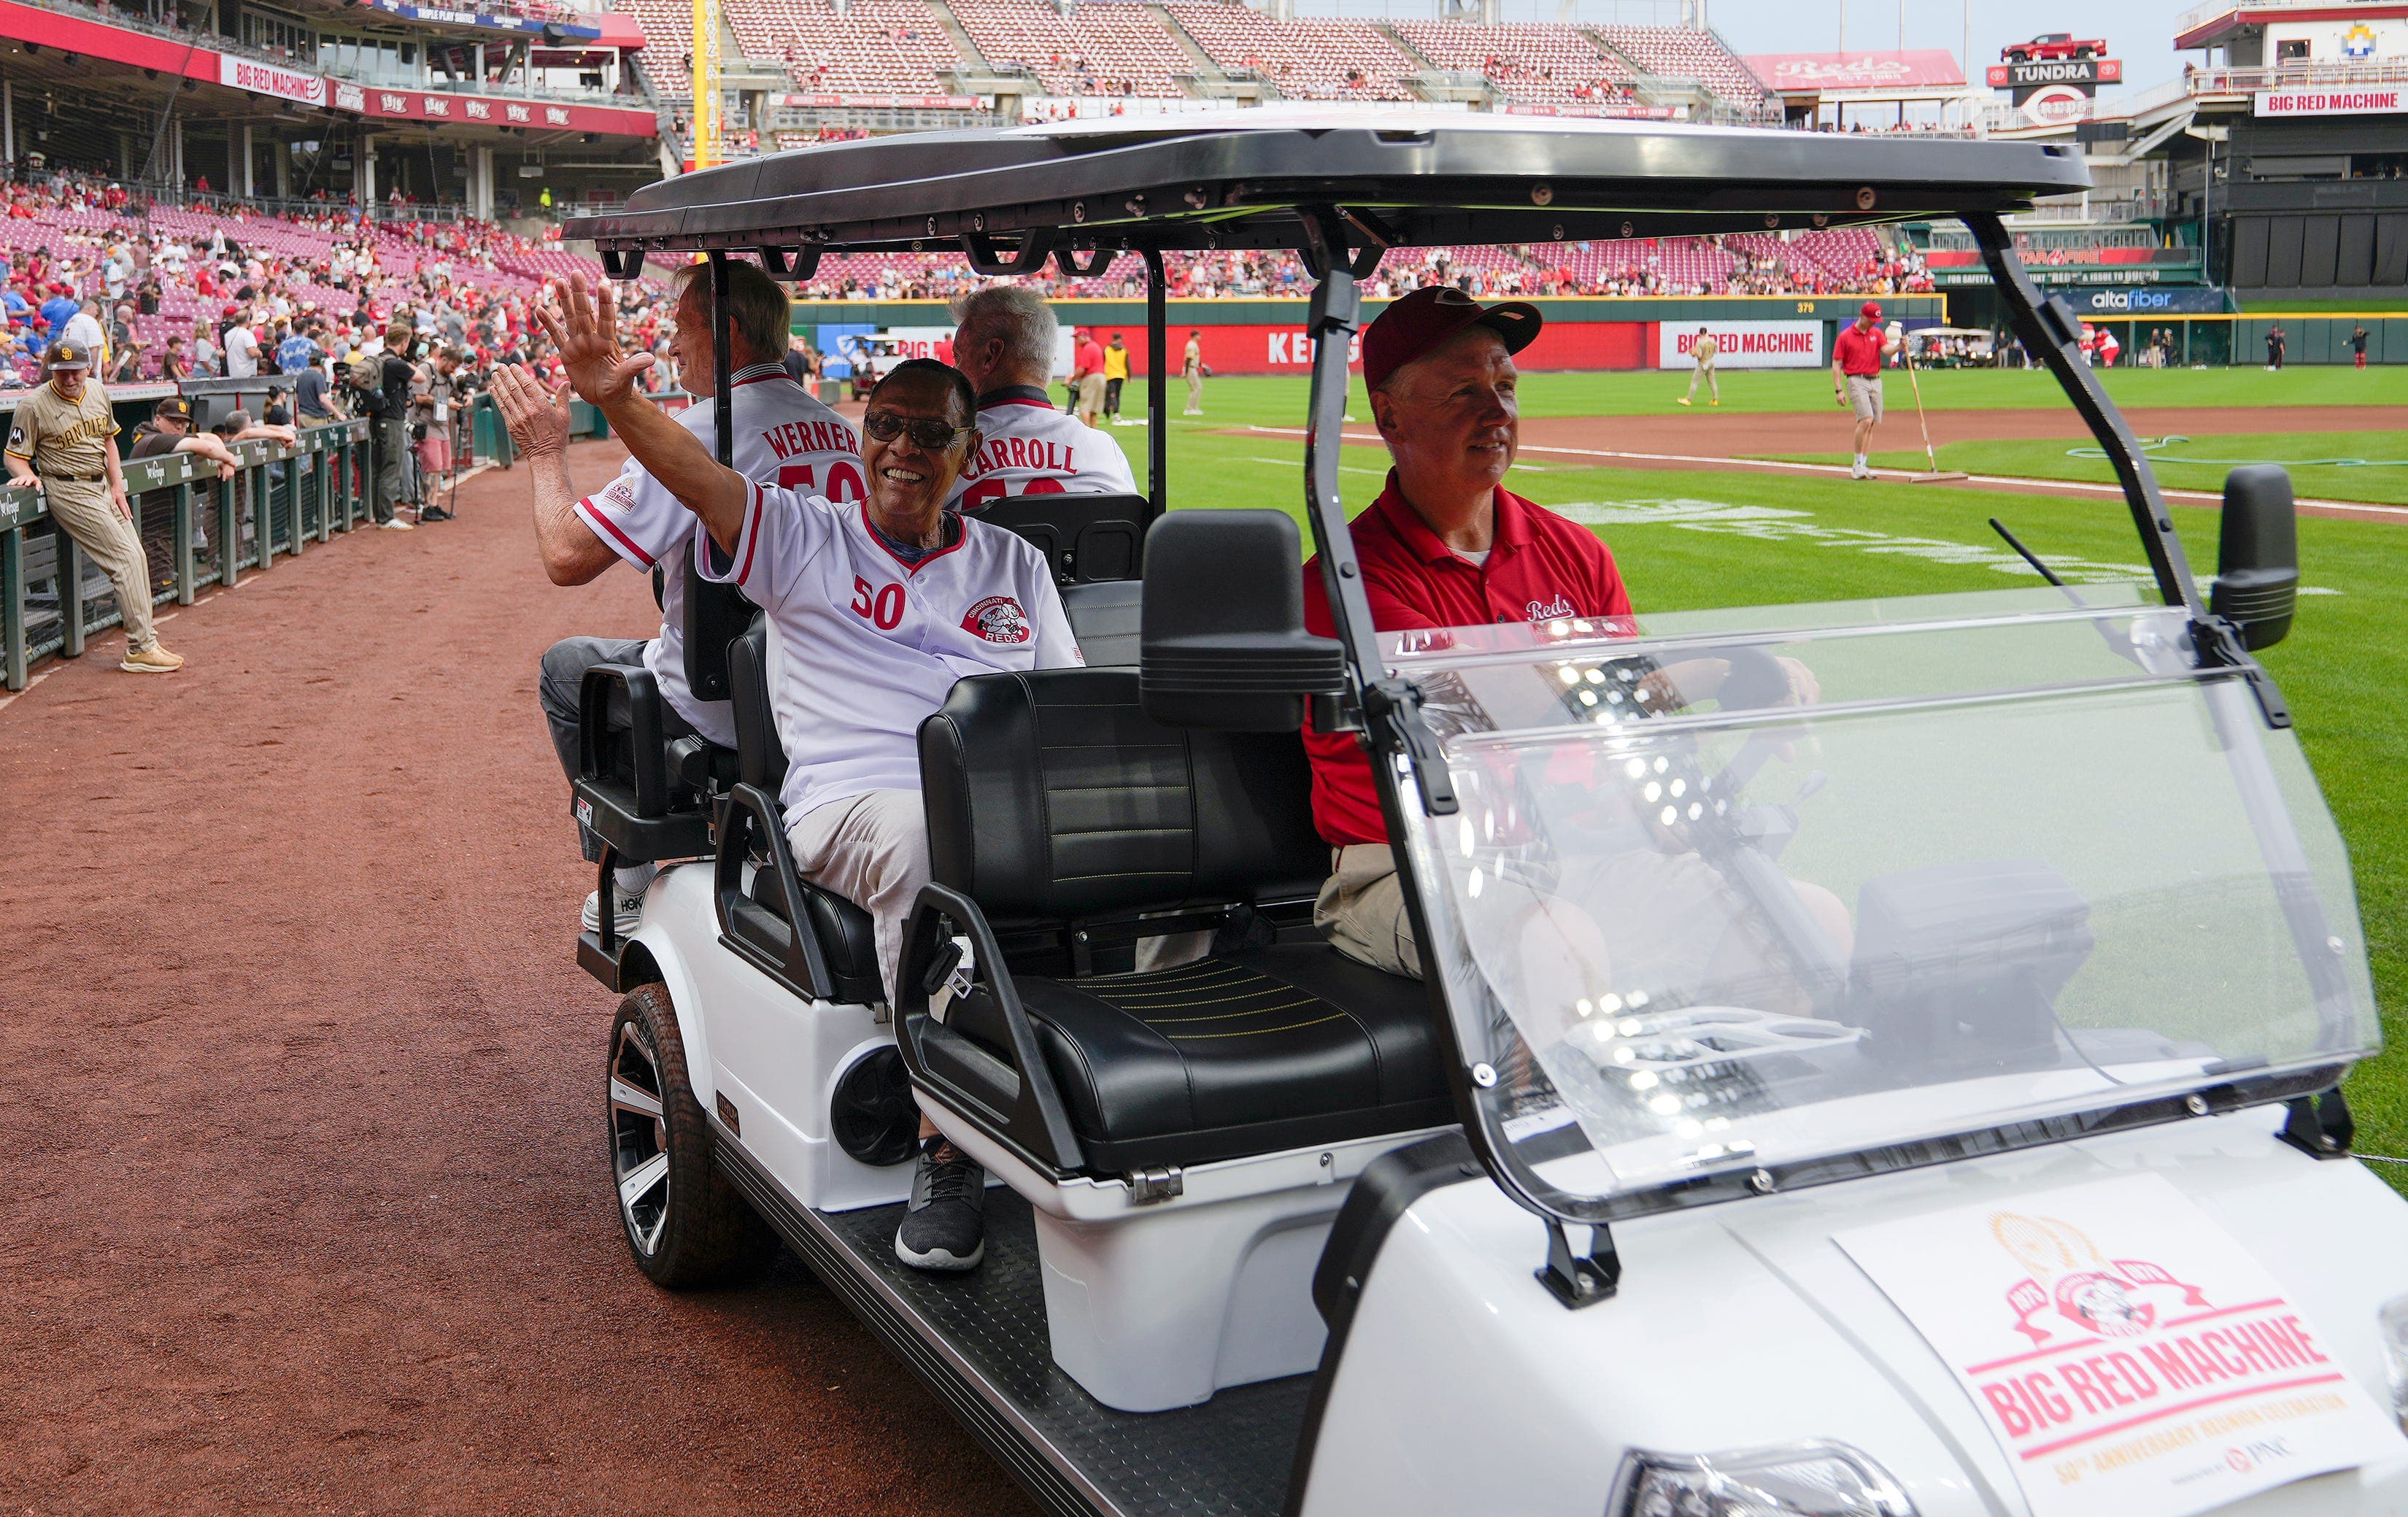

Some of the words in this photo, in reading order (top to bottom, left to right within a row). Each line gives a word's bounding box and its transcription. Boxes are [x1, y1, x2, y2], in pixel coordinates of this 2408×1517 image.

[237, 63, 252, 86] BIG
[254, 67, 270, 91] RED
[272, 72, 309, 99] MACHINE
[2015, 63, 2091, 82] TUNDRA
[2269, 96, 2293, 112] BIG
[2297, 95, 2326, 110] RED
[2329, 93, 2399, 109] MACHINE
[2018, 250, 2047, 264] TAR
[1797, 302, 1815, 314] 379
[2091, 290, 2172, 311] altafiber
[1742, 333, 1813, 353] MACHINE
[55, 424, 83, 452] SAN
[762, 420, 862, 461] WERNER
[850, 574, 906, 630] 50
[968, 598, 1003, 619] CINCINNATI
[1526, 593, 1575, 622] Reds
[985, 632, 1020, 644] REDS
[620, 896, 644, 913] HOK
[1979, 1372, 2073, 1439] BIG
[2056, 1351, 2161, 1415] RED
[2139, 1314, 2331, 1391] MACHINE
